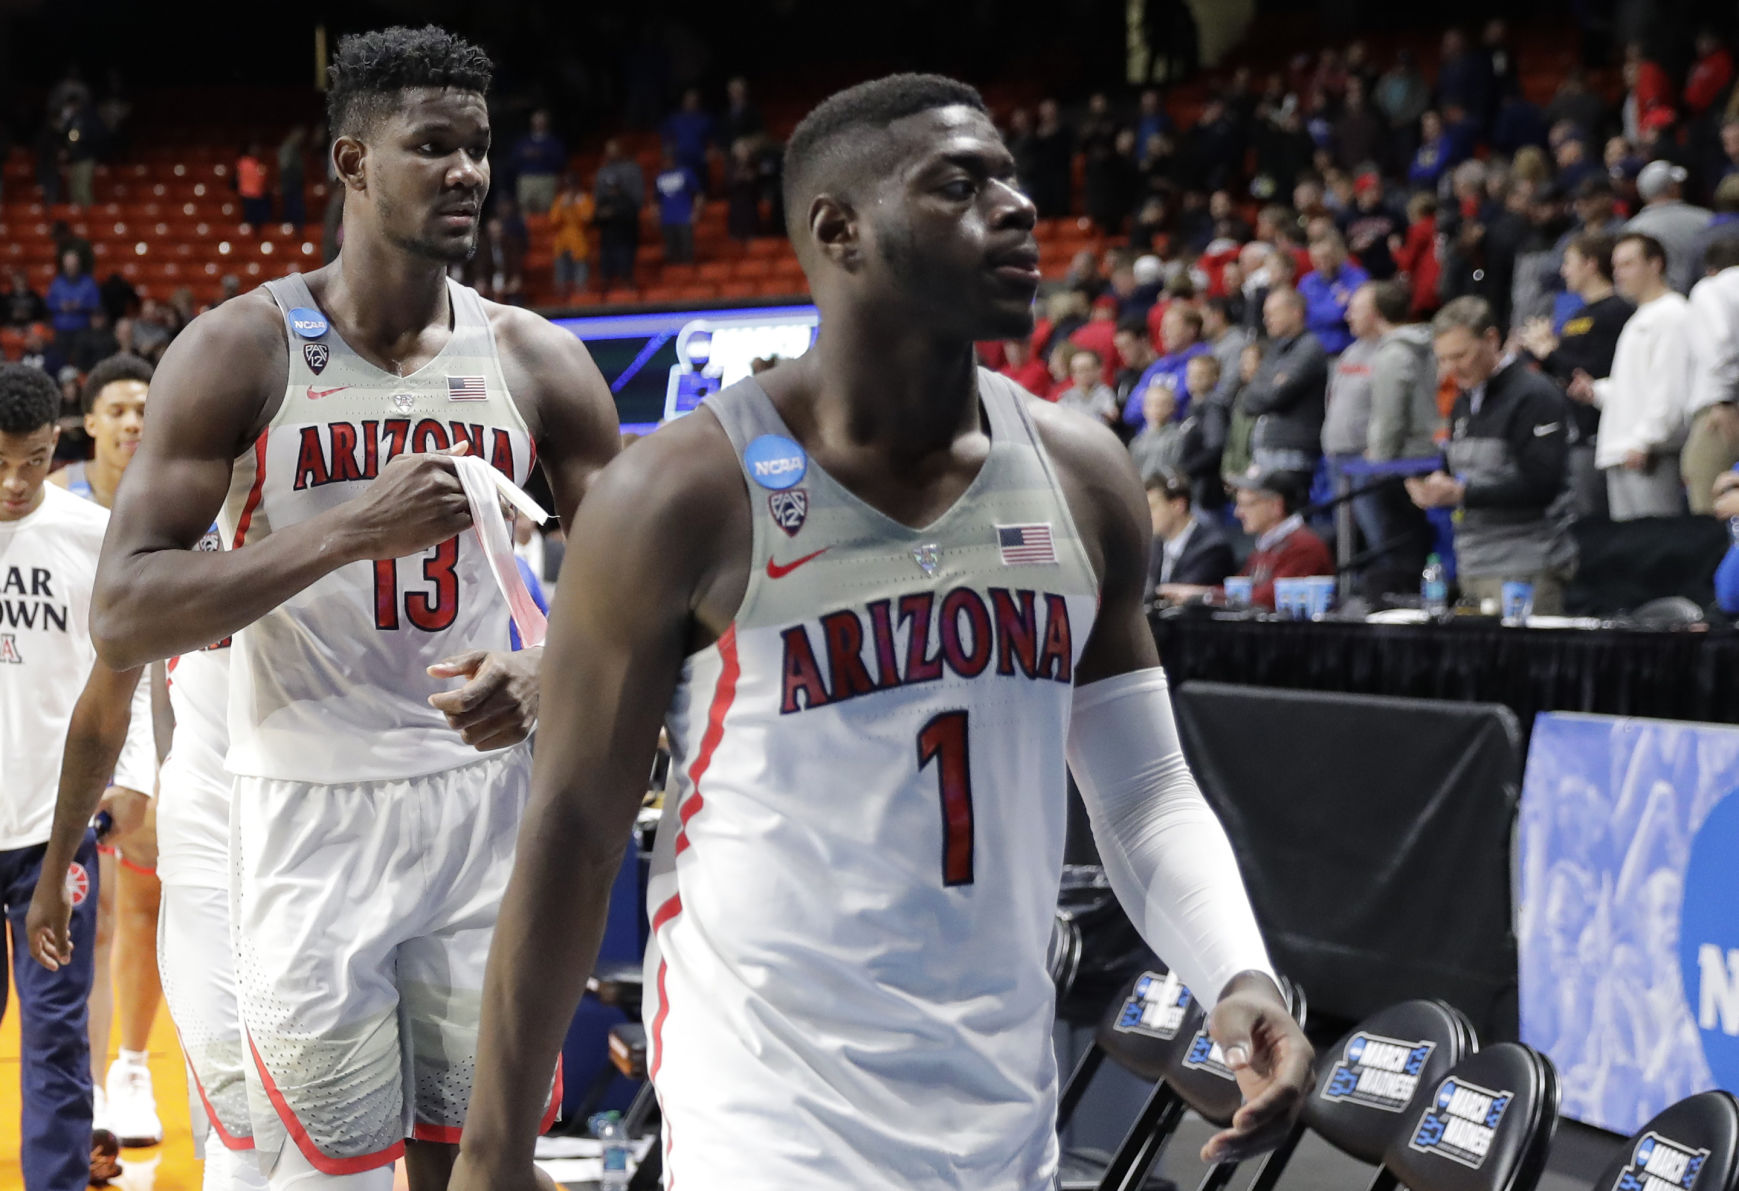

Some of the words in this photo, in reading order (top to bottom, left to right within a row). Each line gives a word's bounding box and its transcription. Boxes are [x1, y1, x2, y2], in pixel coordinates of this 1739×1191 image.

[294, 319, 328, 330] NCAA
[305, 344, 328, 361] PAC
[311, 356, 323, 367] 12
[293, 418, 515, 491] ARIZONA
[754, 456, 805, 477] NCAA
[770, 491, 806, 519] PAC
[781, 509, 800, 527] 12
[0, 565, 54, 598] AR
[372, 533, 460, 633] 13
[0, 599, 68, 632] WN
[778, 586, 1073, 716] ARIZONA
[916, 709, 975, 887] 1
